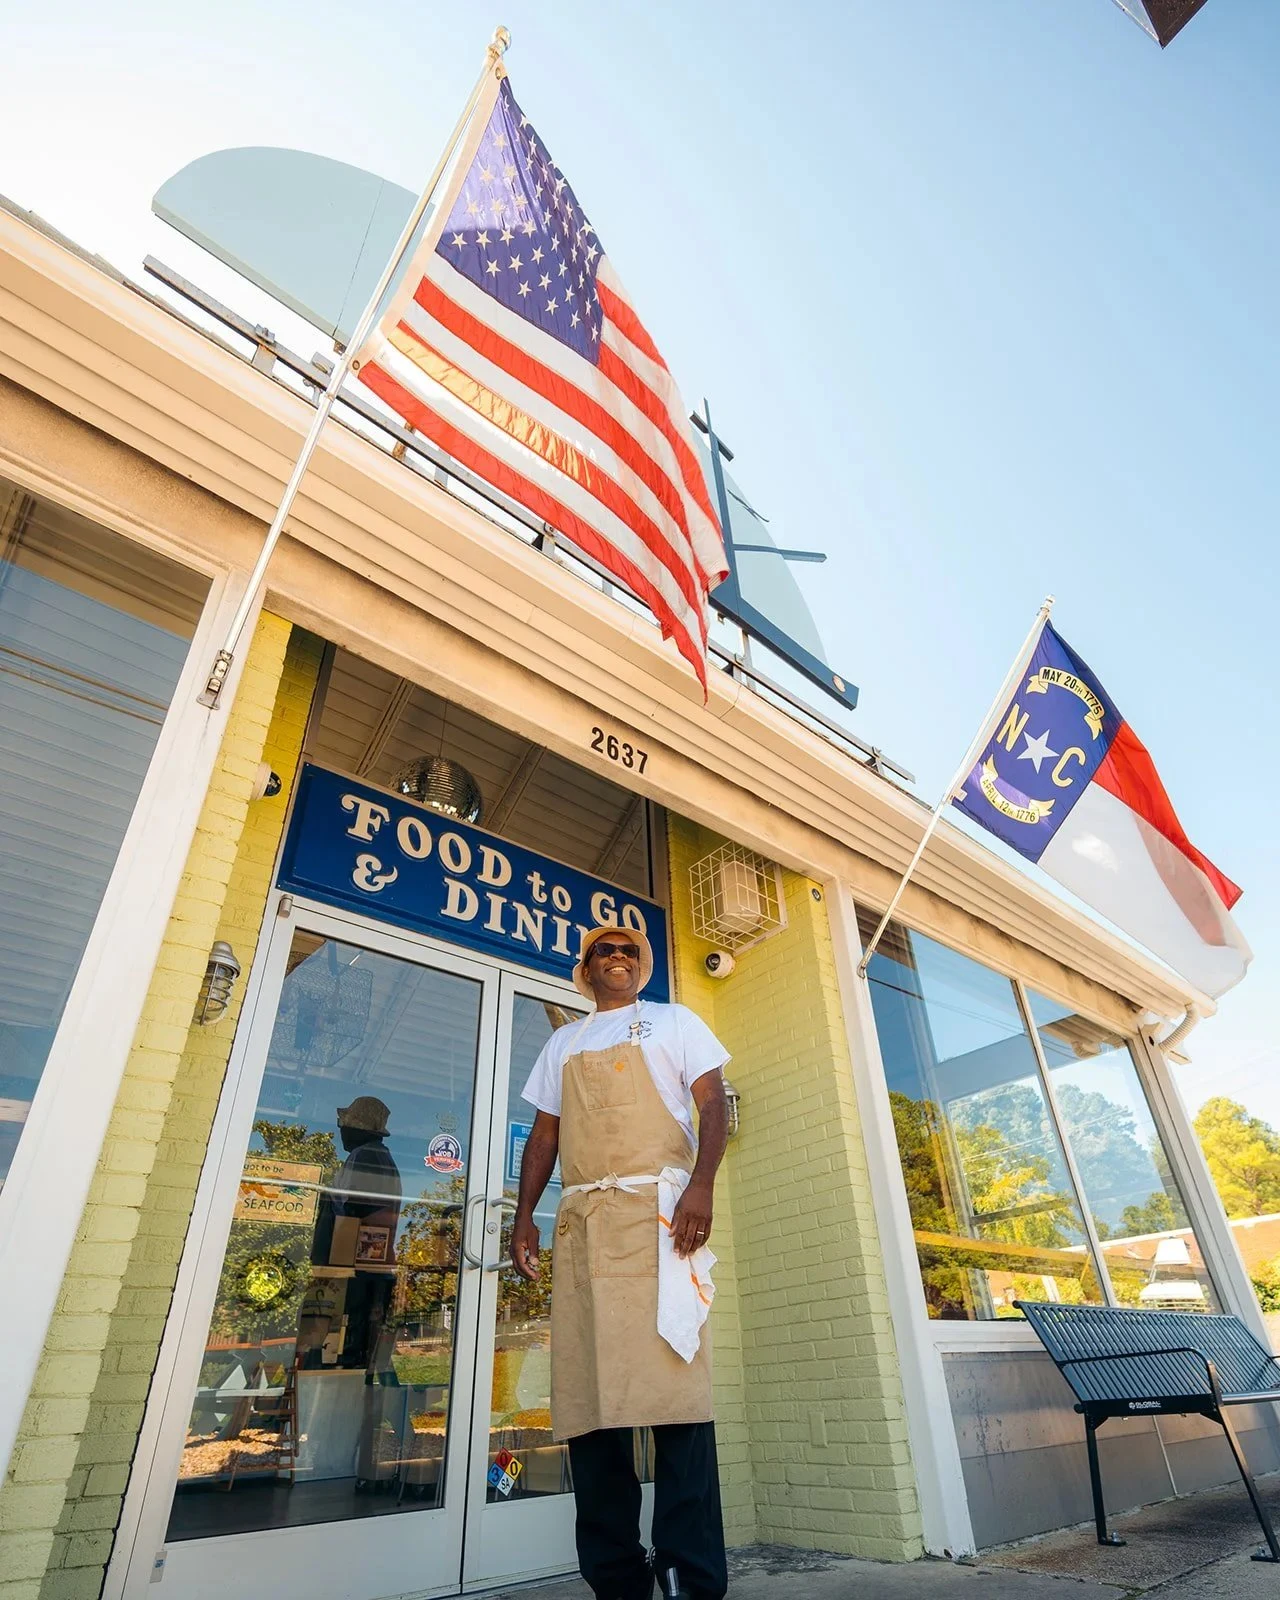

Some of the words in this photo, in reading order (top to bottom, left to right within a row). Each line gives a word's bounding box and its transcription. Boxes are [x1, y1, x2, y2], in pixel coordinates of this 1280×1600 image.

[1042, 668, 1062, 683] MAY
[1063, 675, 1083, 695] 20TH
[1083, 690, 1103, 715] 1775
[590, 726, 649, 775] 2637
[996, 702, 1030, 752] N
[1051, 746, 1086, 788] C
[982, 778, 999, 804] APRIL
[1015, 809, 1036, 822] 1776
[341, 793, 513, 888] FOOD
[527, 871, 573, 913] to
[590, 891, 648, 938] GO
[352, 853, 399, 893] &
[440, 877, 590, 960] DINI
[243, 1163, 259, 1171] got
[261, 1164, 271, 1172] to
[272, 1166, 284, 1174] be
[243, 1197, 304, 1213] SEAFOOD
[491, 1466, 500, 1482] 3
[510, 1461, 518, 1476] 0
[500, 1452, 509, 1467] 0
[500, 1478, 511, 1490] SA
